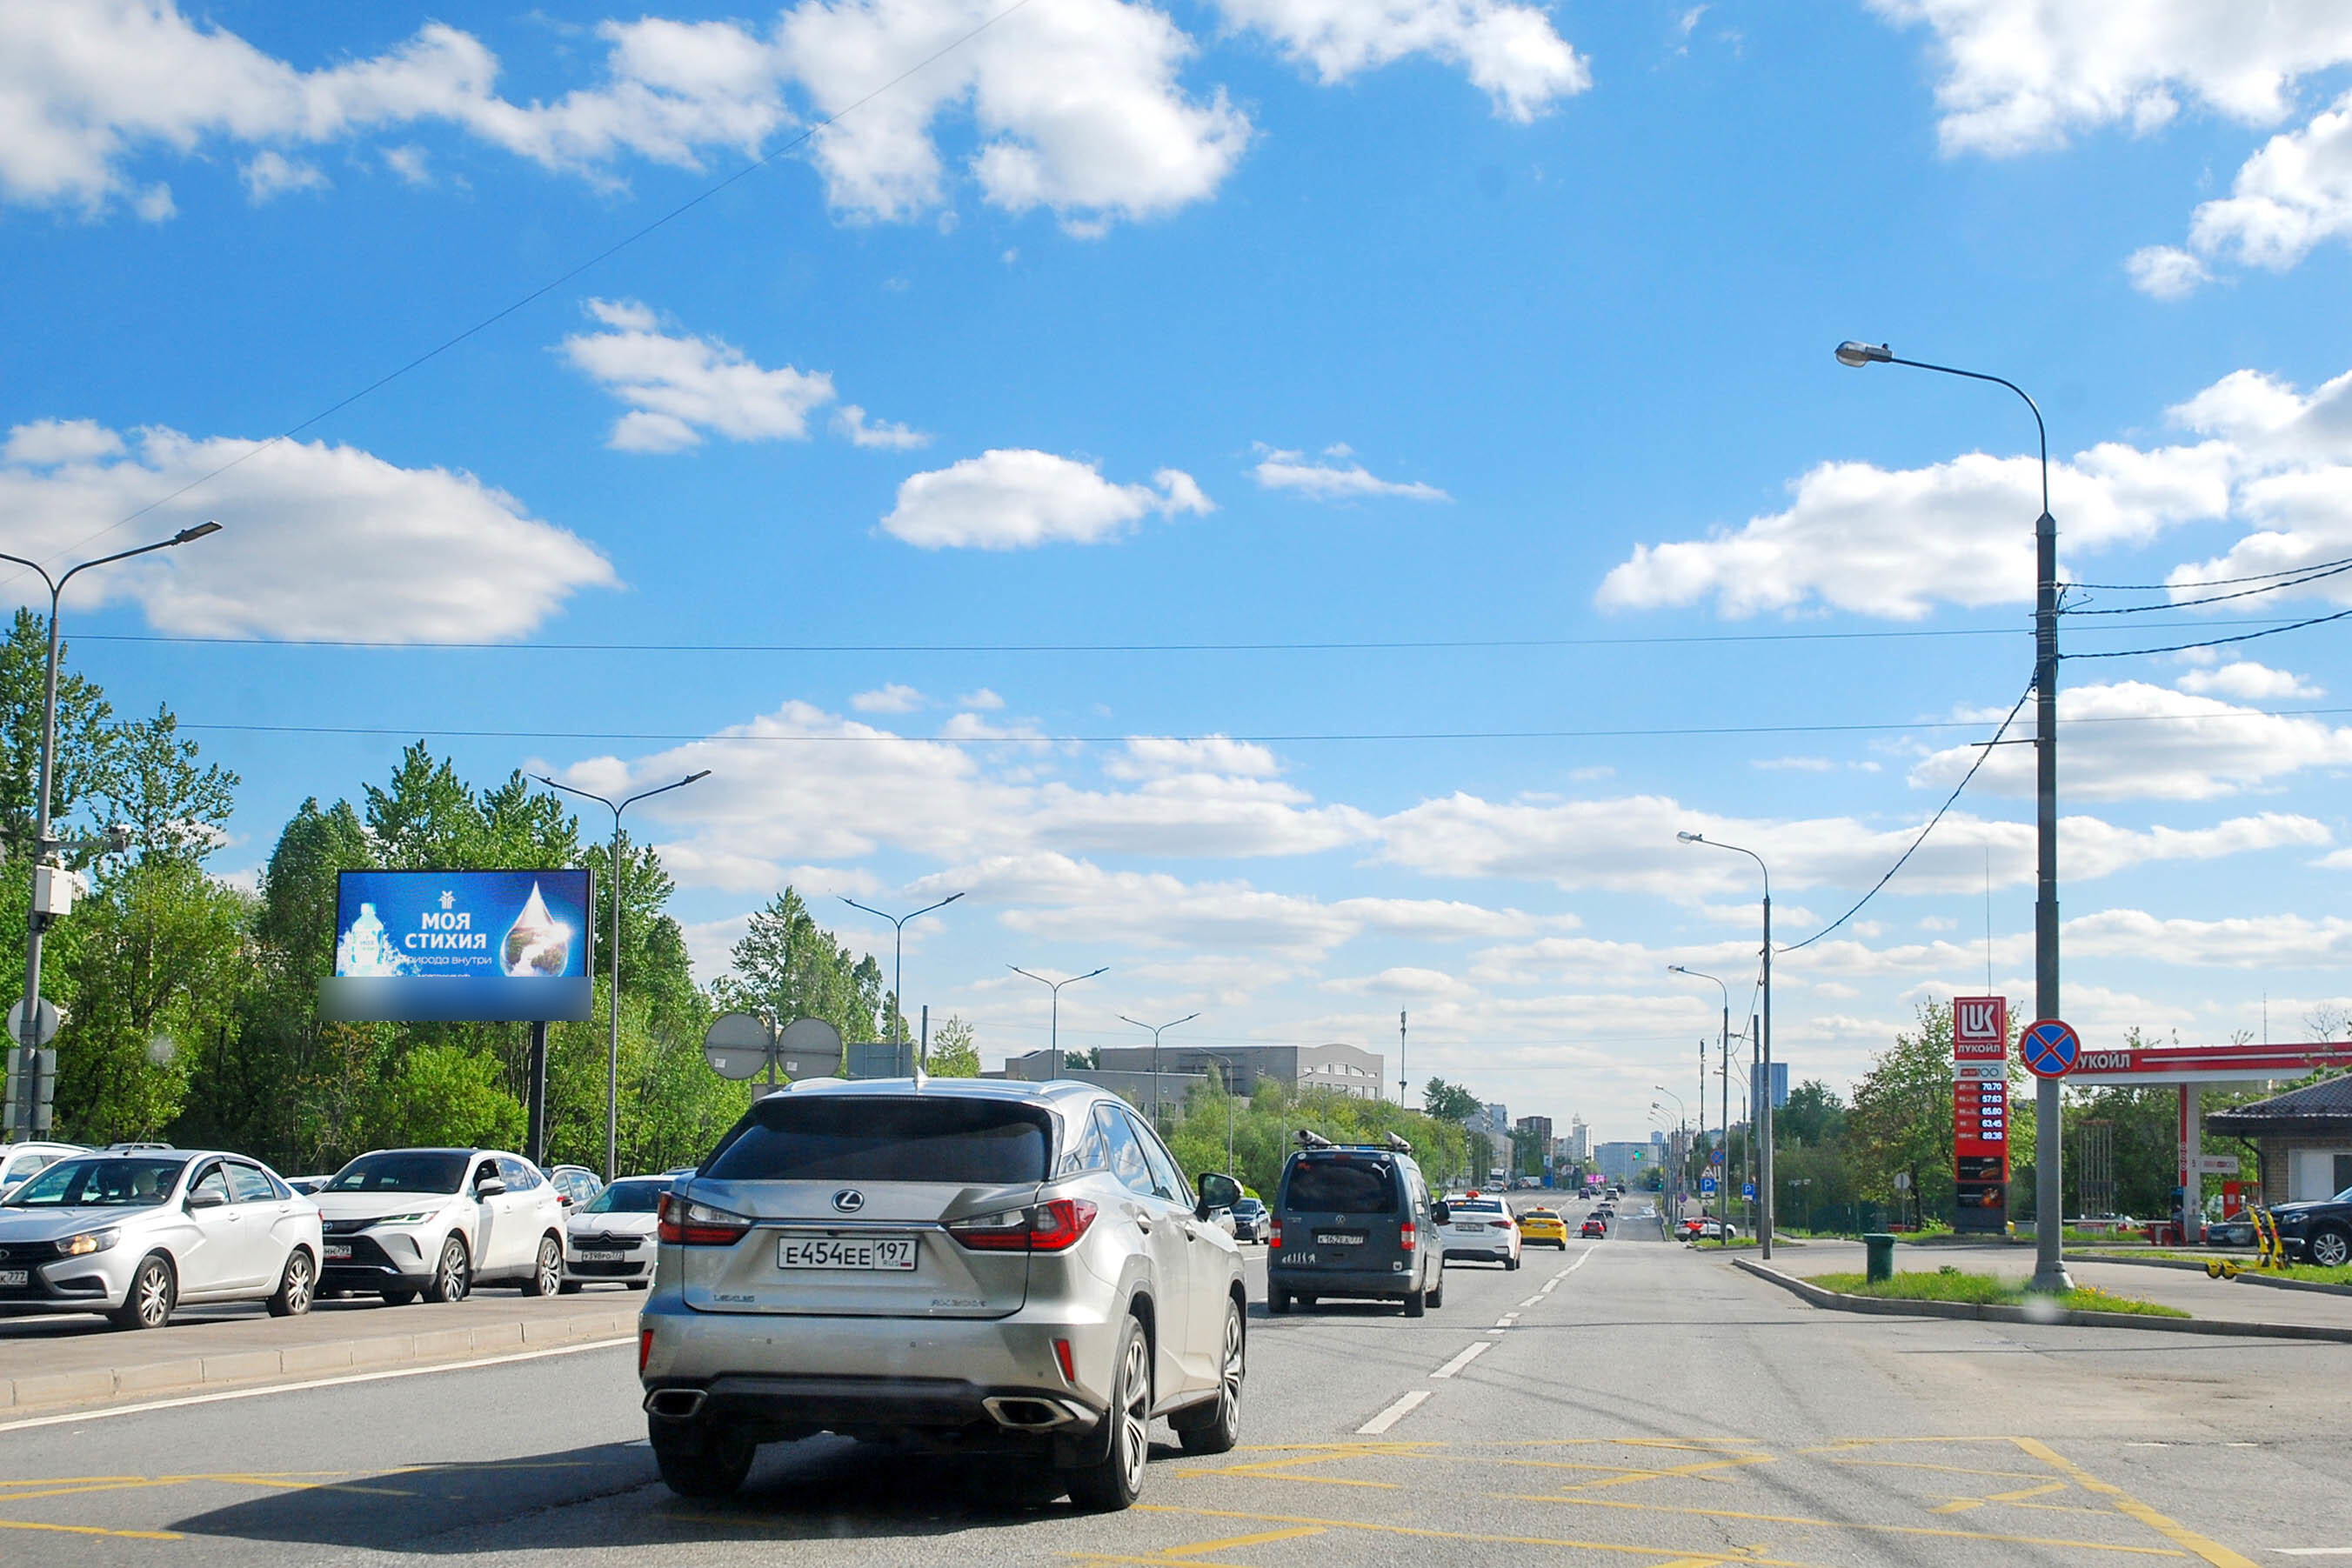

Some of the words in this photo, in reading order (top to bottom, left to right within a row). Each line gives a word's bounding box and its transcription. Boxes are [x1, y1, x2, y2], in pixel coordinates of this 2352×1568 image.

[422, 912, 471, 930] МОЯ
[404, 933, 486, 949] СТИХИЯ
[451, 957, 492, 966] внутри
[1958, 1043, 2001, 1053] ЛУКОЙЛ
[786, 1242, 871, 1265] Е454ЕЕ
[877, 1243, 909, 1260] 197
